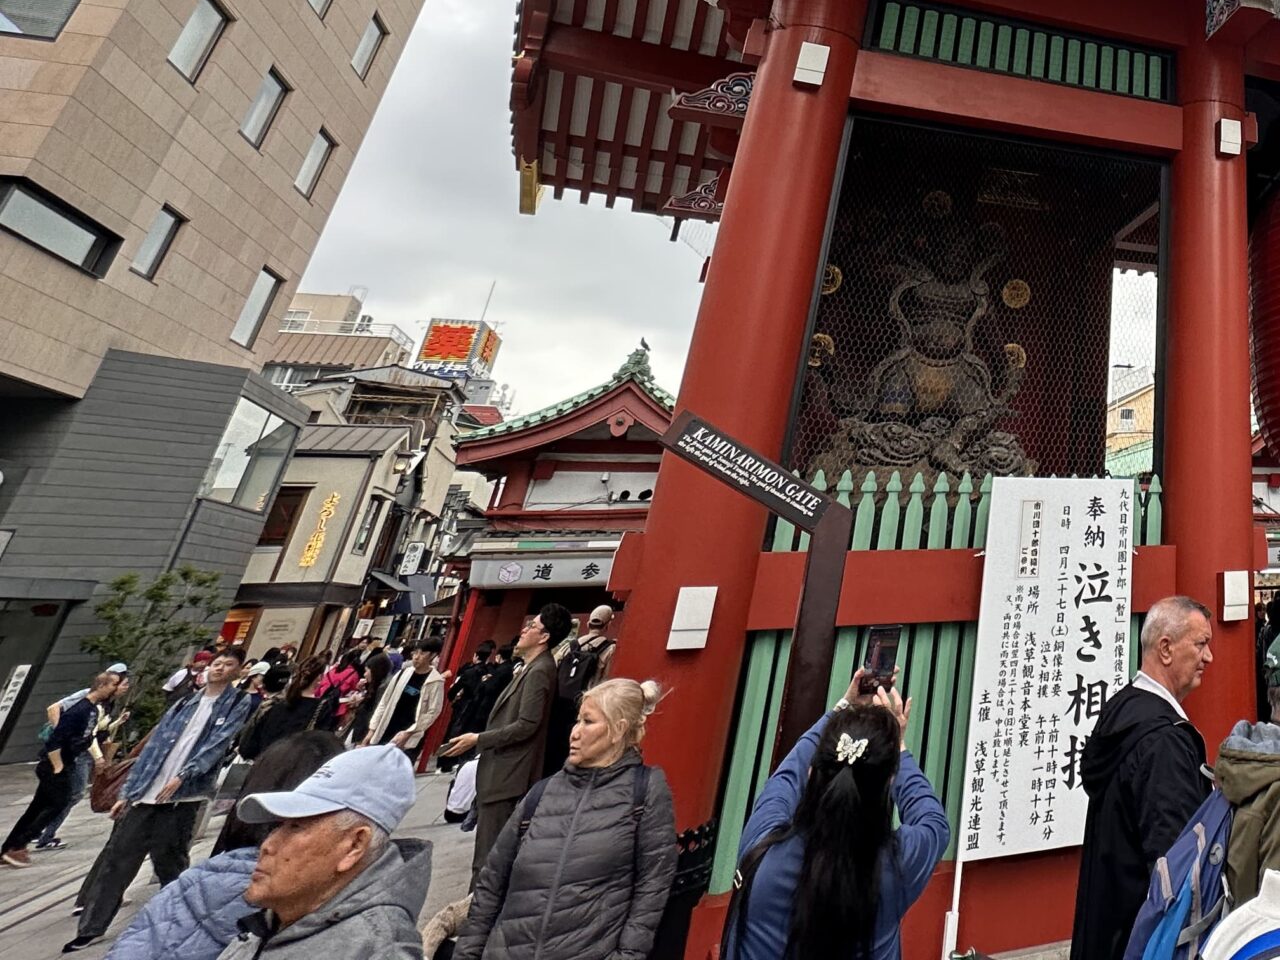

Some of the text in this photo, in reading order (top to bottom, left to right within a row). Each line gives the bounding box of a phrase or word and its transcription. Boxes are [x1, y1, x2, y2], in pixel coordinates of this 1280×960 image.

[423, 323, 477, 360] 薬
[693, 427, 822, 511] KAMINARIMON GATE
[1060, 505, 1072, 530] 日時
[1083, 496, 1106, 549] 奉納
[1018, 585, 1040, 748] 場所 浅草観音本堂裏
[966, 689, 992, 852] 主催 浅草観光連盟
[1029, 640, 1051, 826] 泣き相撲 午前十一時十分
[1042, 639, 1065, 841] 銅像法要 午前十時四十五分
